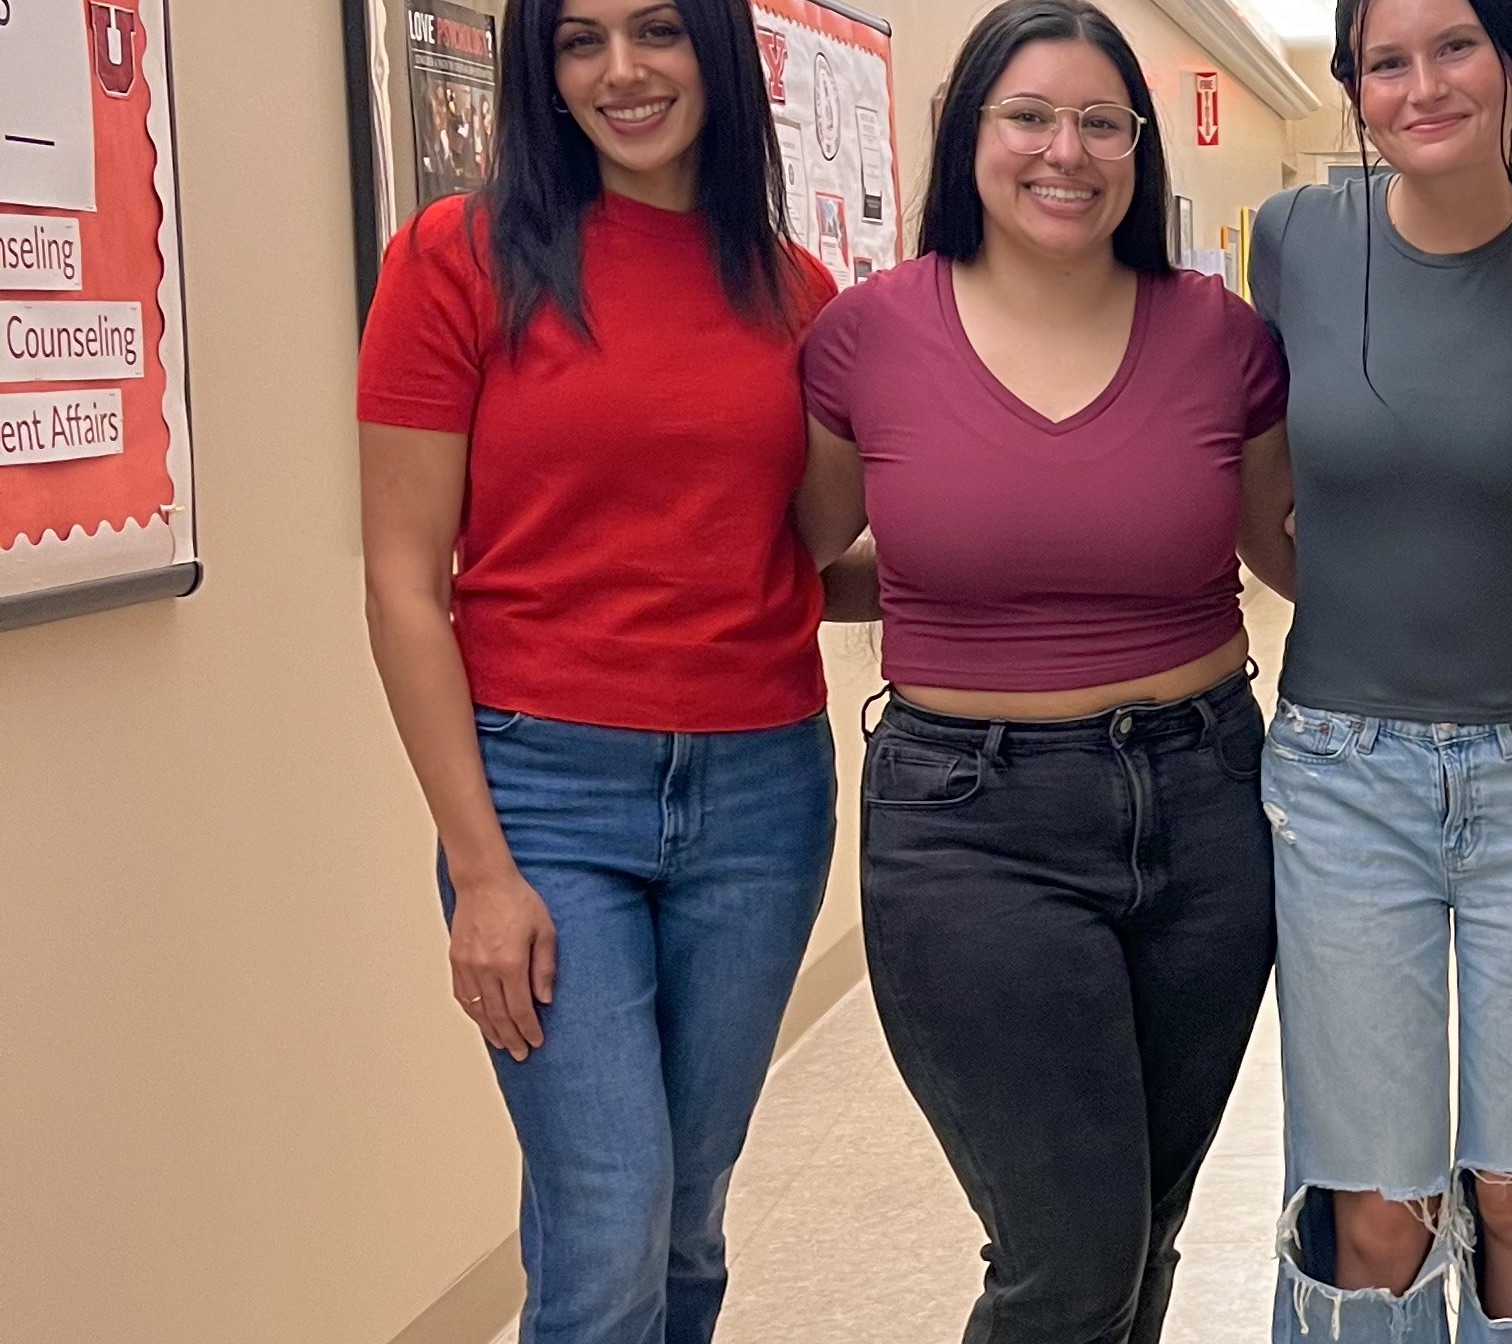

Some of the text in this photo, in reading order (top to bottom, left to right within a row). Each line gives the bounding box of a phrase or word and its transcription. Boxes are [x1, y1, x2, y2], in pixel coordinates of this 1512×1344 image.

[408, 10, 435, 44] LOVE
[7, 315, 137, 365] Counseling
[1, 402, 119, 452] ent Affairs
